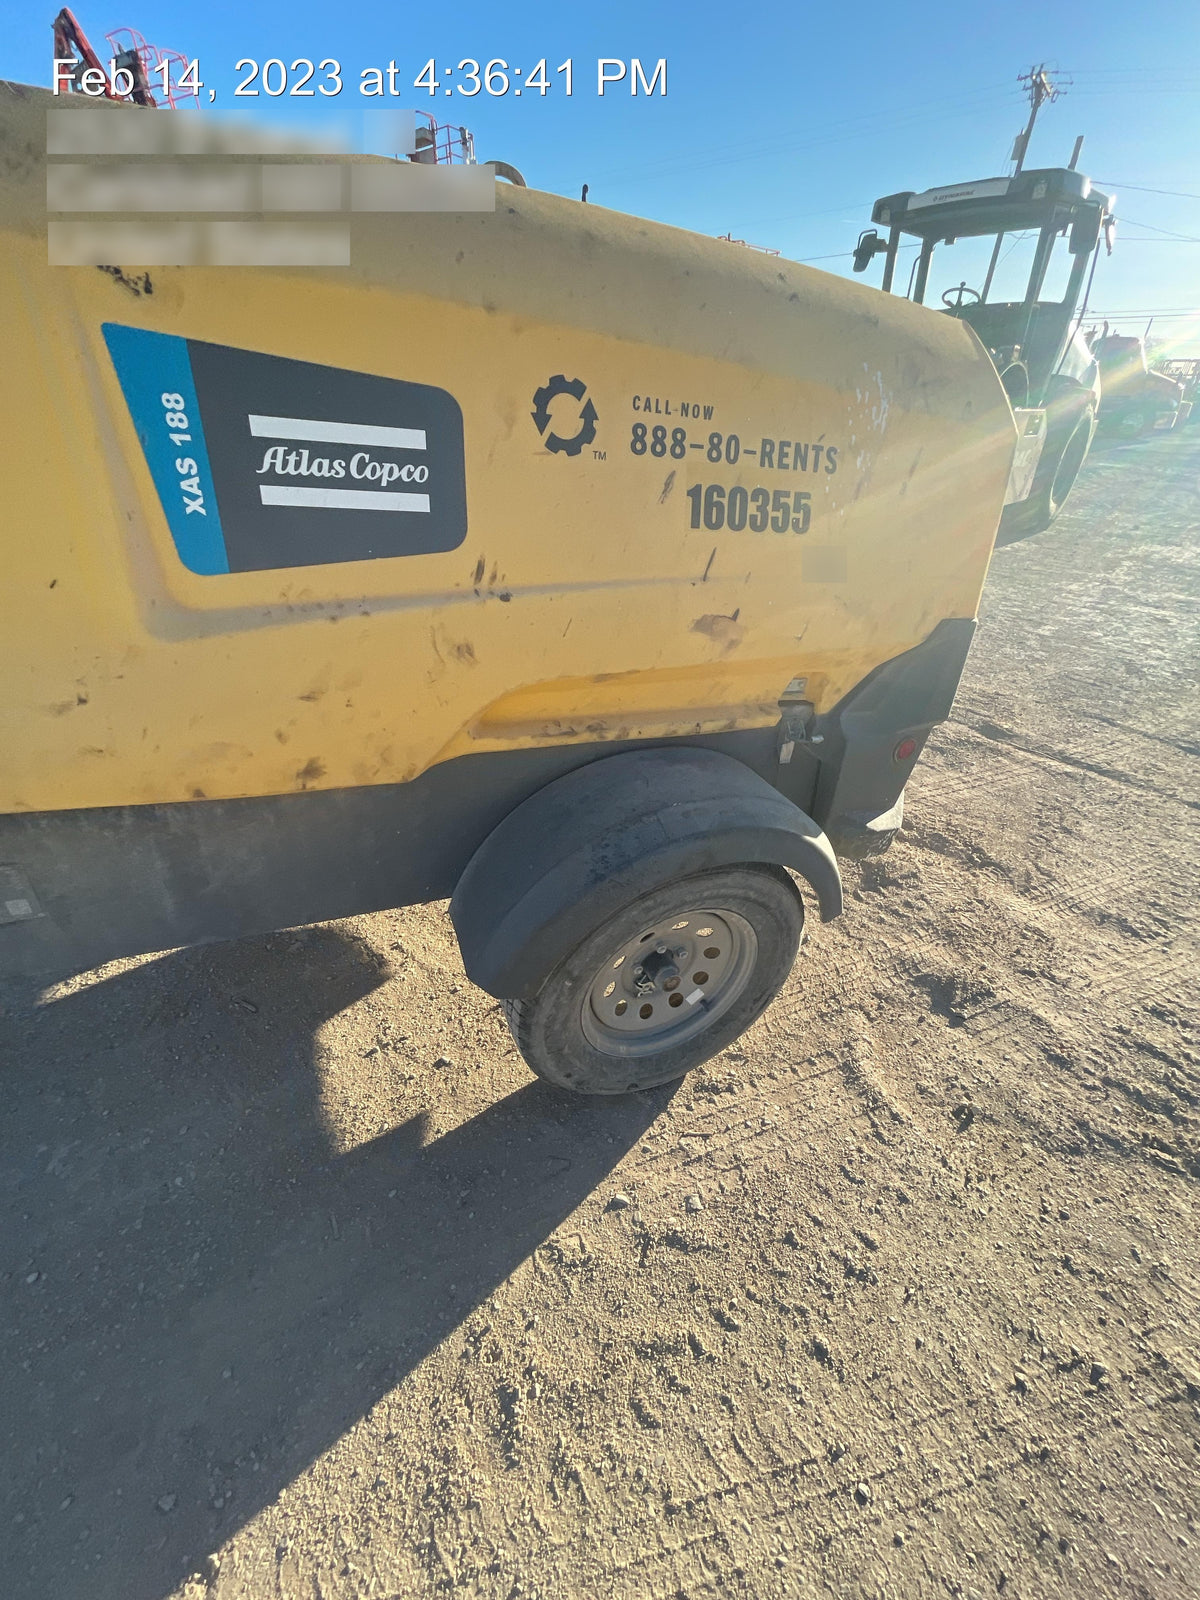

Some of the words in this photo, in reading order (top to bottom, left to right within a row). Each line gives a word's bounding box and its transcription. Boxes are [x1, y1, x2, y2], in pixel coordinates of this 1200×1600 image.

[161, 392, 192, 447] 188
[632, 395, 672, 415] CALL
[680, 402, 714, 421] NOW
[256, 446, 346, 478] Atlas
[350, 452, 429, 487] Copco
[630, 422, 838, 474] 888-80-RENTS
[175, 457, 207, 516] XAS
[686, 483, 812, 534] 160355
